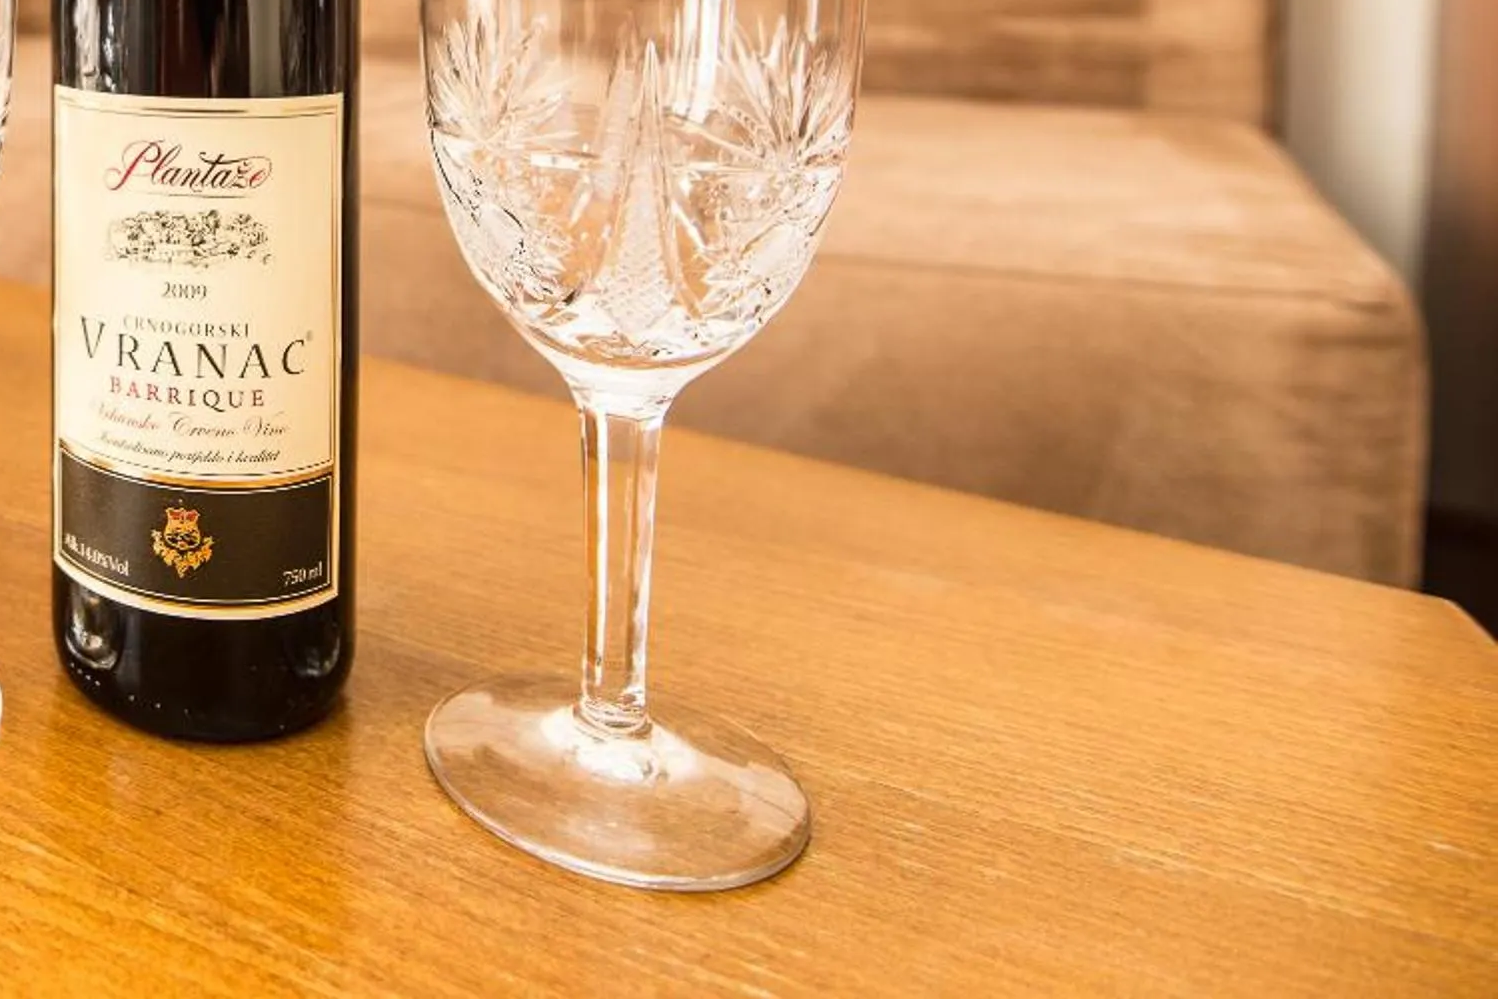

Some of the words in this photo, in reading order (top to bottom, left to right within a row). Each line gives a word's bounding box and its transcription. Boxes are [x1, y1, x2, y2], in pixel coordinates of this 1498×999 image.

[103, 139, 273, 194] Plantaže
[161, 281, 208, 301] 2009
[122, 314, 250, 339] CRNOGORSKI
[80, 315, 305, 380] VRANAC
[109, 375, 266, 413] BARRIQUE
[242, 411, 291, 437] Vino
[281, 568, 307, 588] 750
